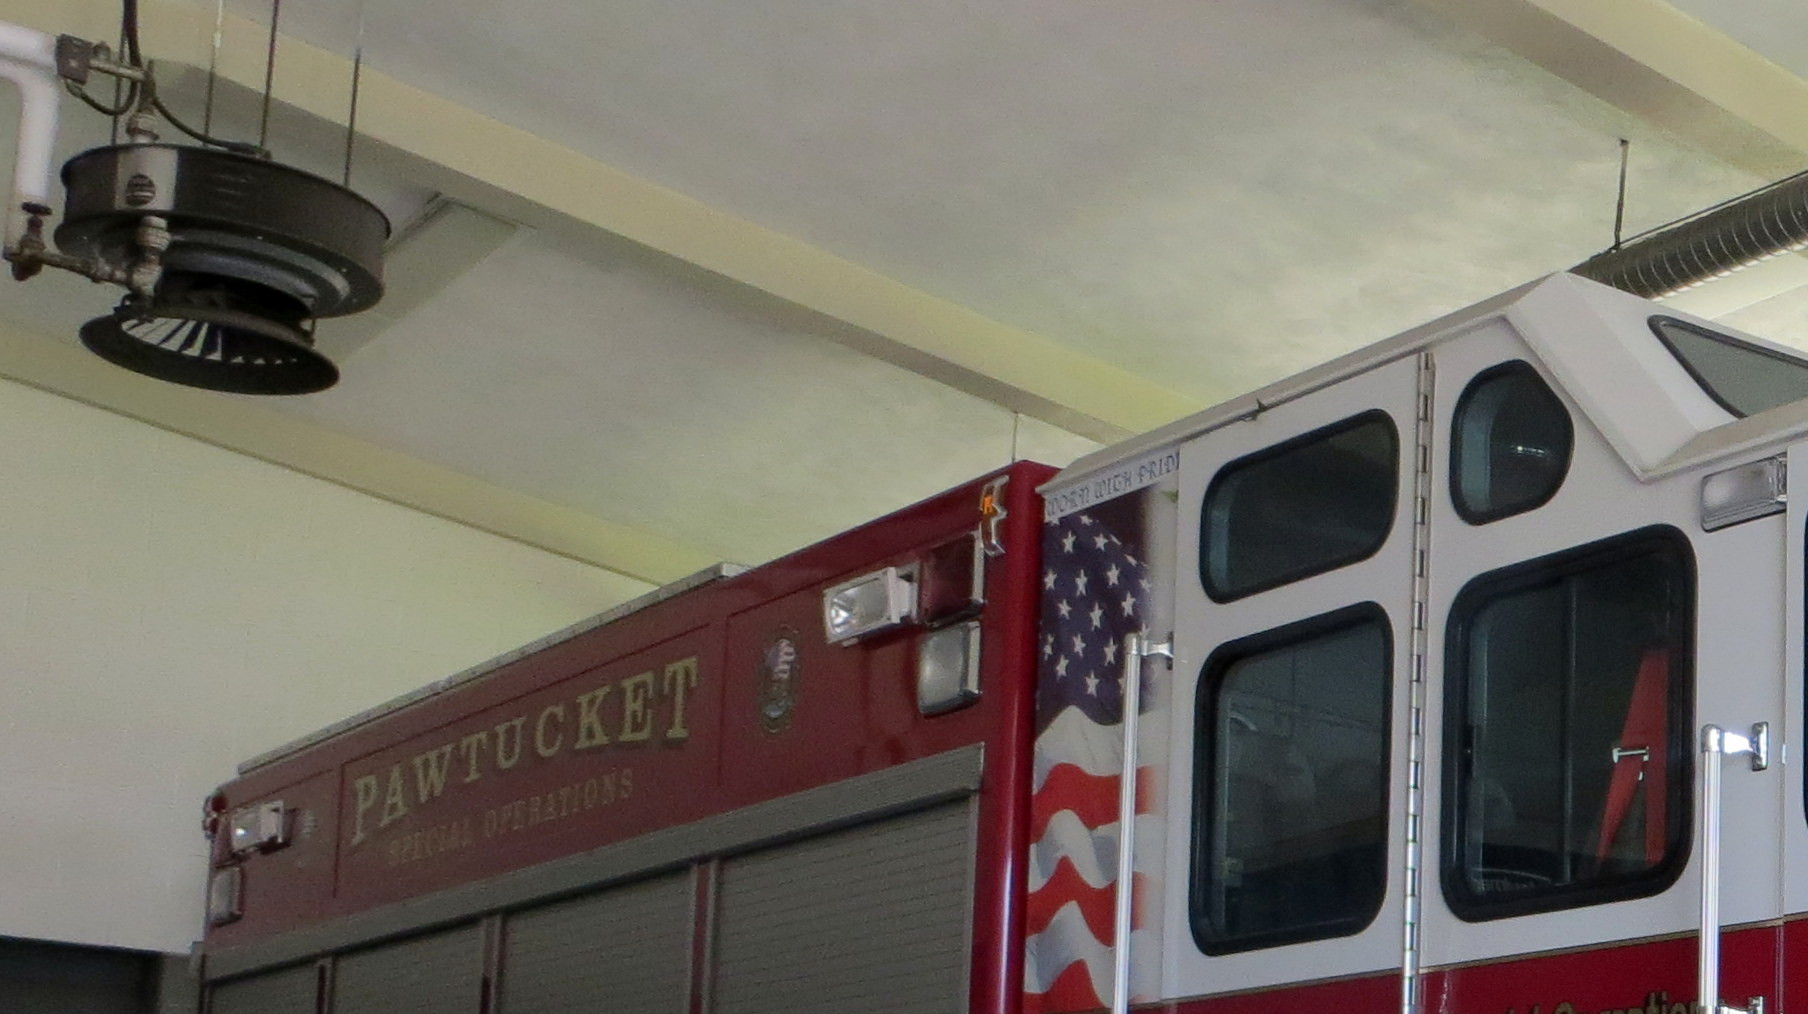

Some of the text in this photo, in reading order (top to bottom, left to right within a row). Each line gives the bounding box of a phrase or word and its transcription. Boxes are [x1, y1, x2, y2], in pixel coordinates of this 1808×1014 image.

[1138, 452, 1179, 481] PRID
[352, 657, 699, 846] PAWTUCKET
[389, 767, 633, 866] SPECIAL OPERATIONS
